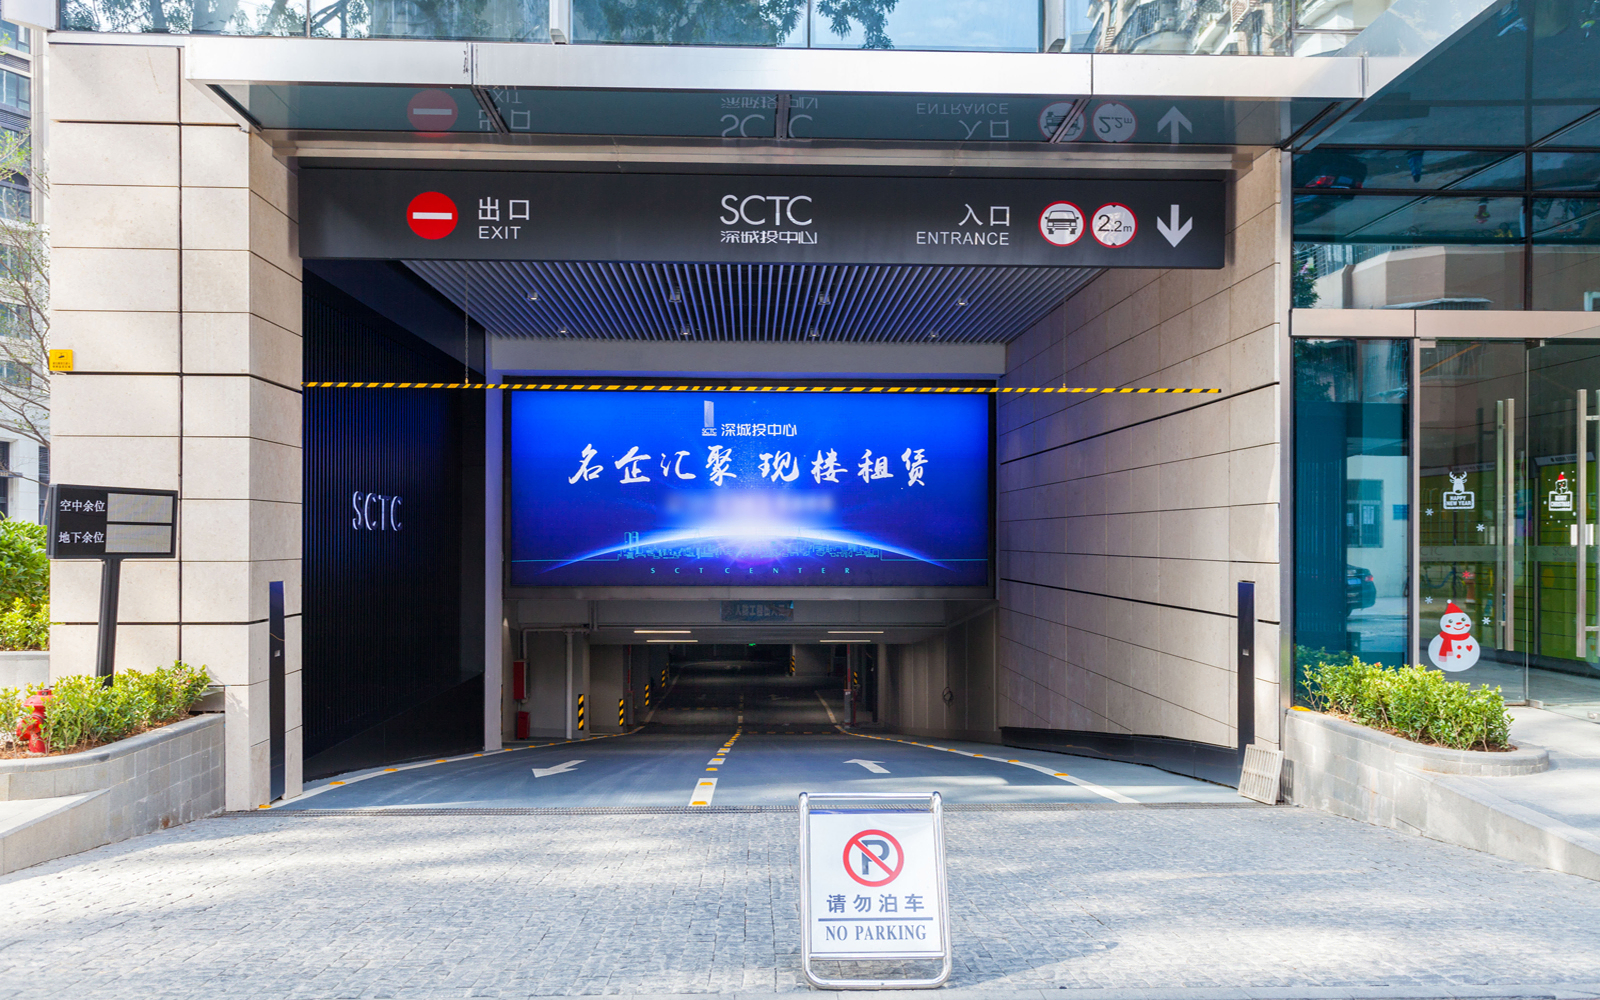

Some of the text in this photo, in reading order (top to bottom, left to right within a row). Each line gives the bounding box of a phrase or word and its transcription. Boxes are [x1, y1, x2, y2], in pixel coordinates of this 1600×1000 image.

[478, 196, 530, 221] 出口
[719, 194, 813, 226] SCTC
[958, 203, 1010, 226] 入口
[1097, 214, 1133, 233] 2.2m
[478, 225, 522, 240] EXIT
[720, 230, 818, 244] 深城投中心
[916, 231, 1010, 246] ENTRANCE
[721, 423, 798, 437] 深城投中心
[60, 499, 106, 512] 空中余位
[352, 490, 403, 532] SCTC
[58, 531, 105, 544] 地下余位
[826, 893, 925, 914] 请勿泊车
[825, 924, 927, 941] NO PARKING
